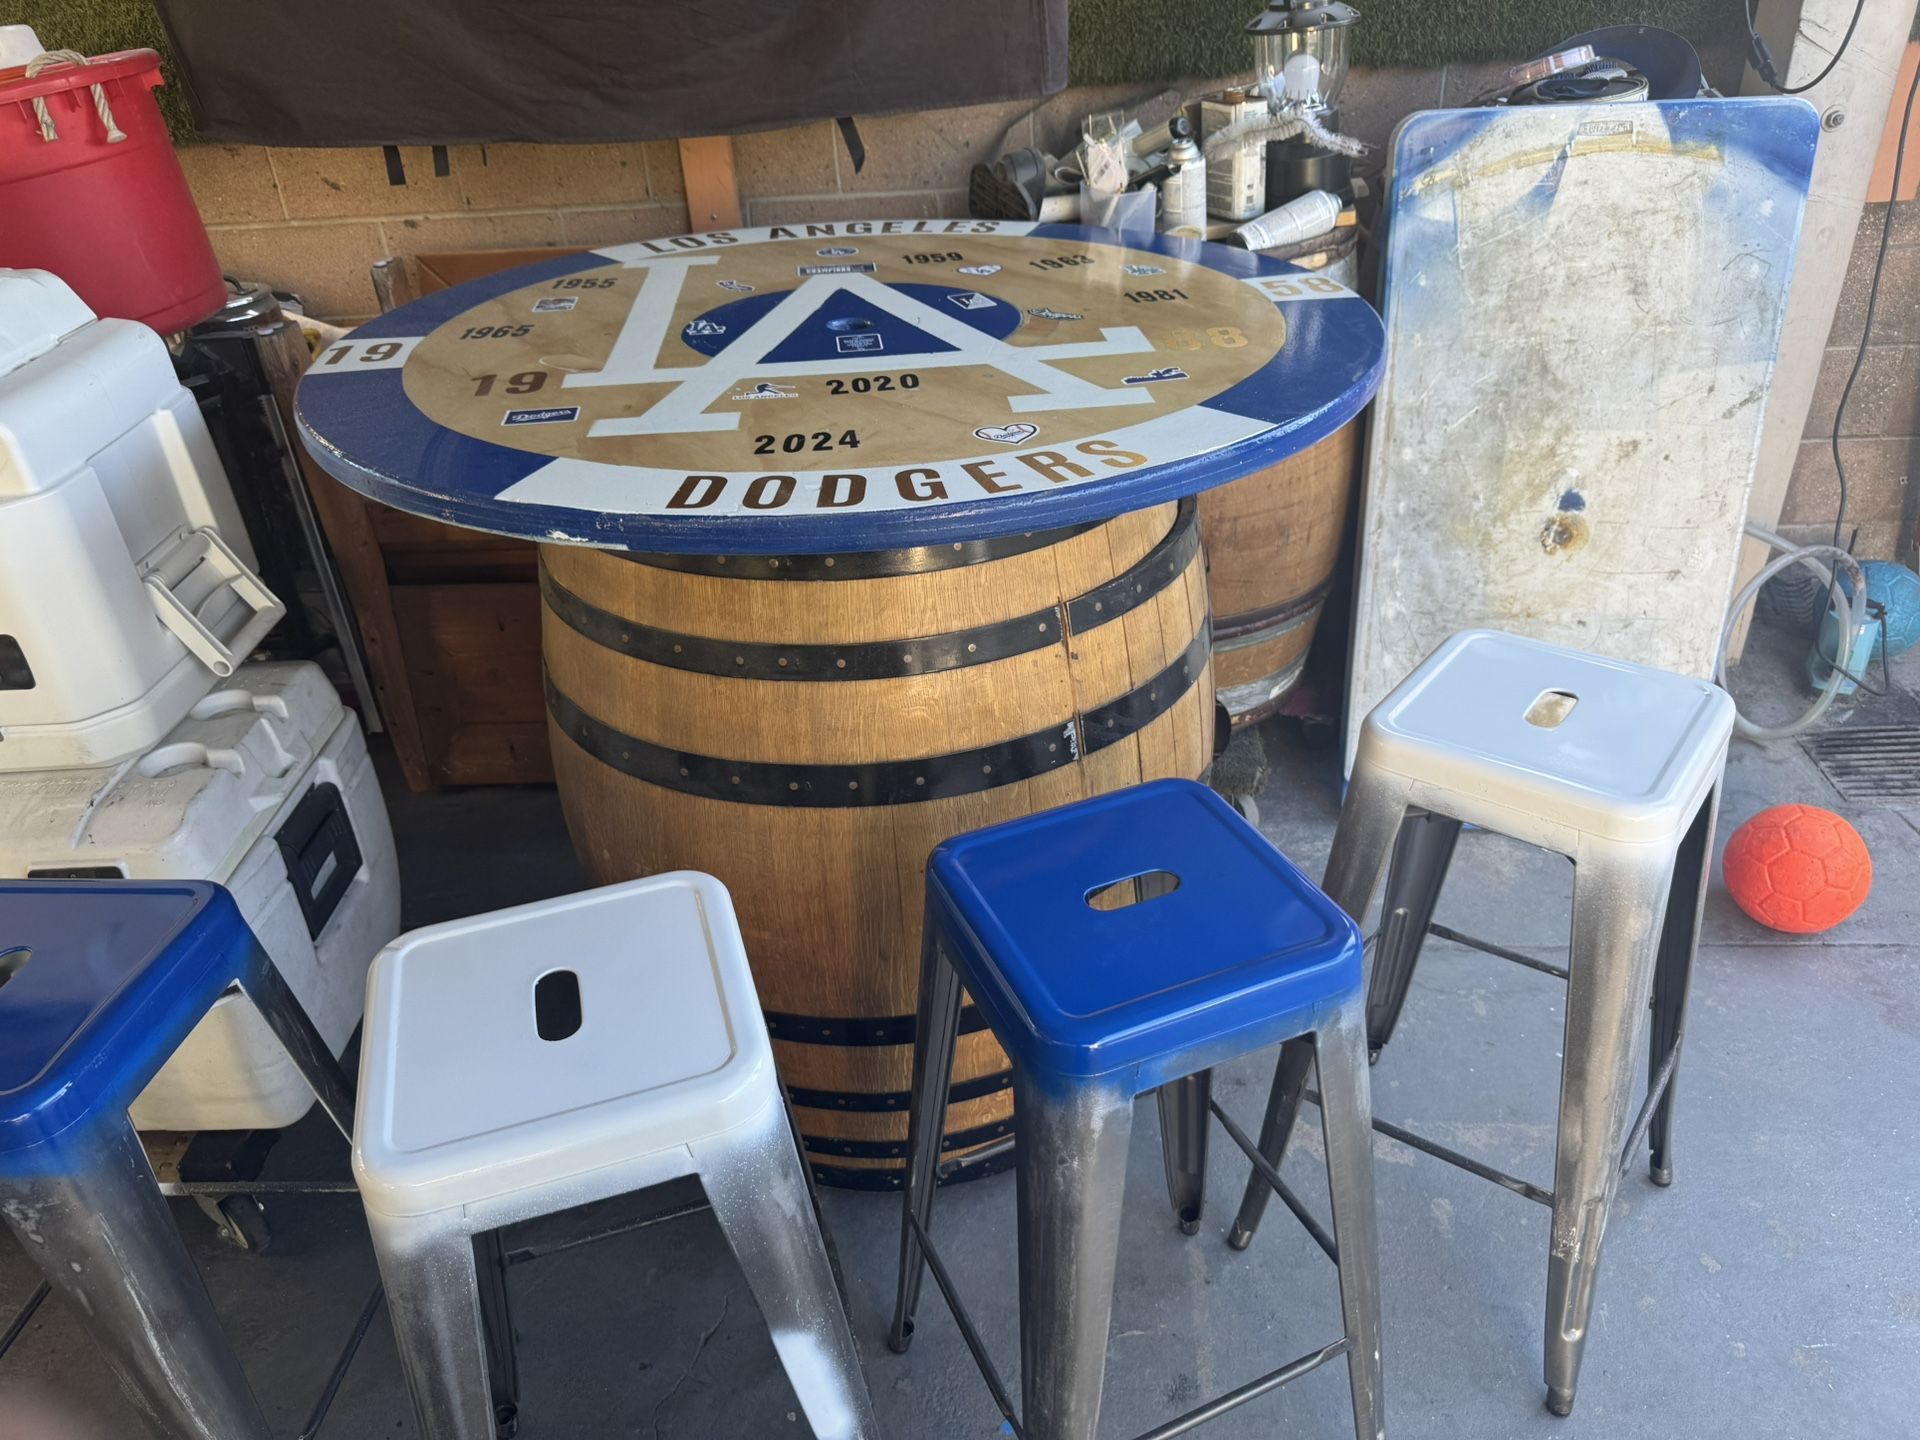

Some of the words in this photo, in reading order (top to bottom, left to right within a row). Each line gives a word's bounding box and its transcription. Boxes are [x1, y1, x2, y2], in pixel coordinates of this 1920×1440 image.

[641, 232, 739, 254] LOS
[769, 221, 1000, 240] ANGELES
[902, 251, 964, 265] 1959
[1028, 254, 1096, 272] 1963
[551, 277, 619, 290] 1955
[1260, 277, 1345, 297] 58
[1123, 287, 1190, 304] 1981
[459, 323, 535, 341] 1965
[323, 341, 404, 366] 19
[470, 370, 549, 398] 19
[825, 373, 920, 396] 2020
[511, 409, 573, 423] Dodgers
[753, 429, 861, 455] 2024
[665, 439, 1149, 510] DODGERS
